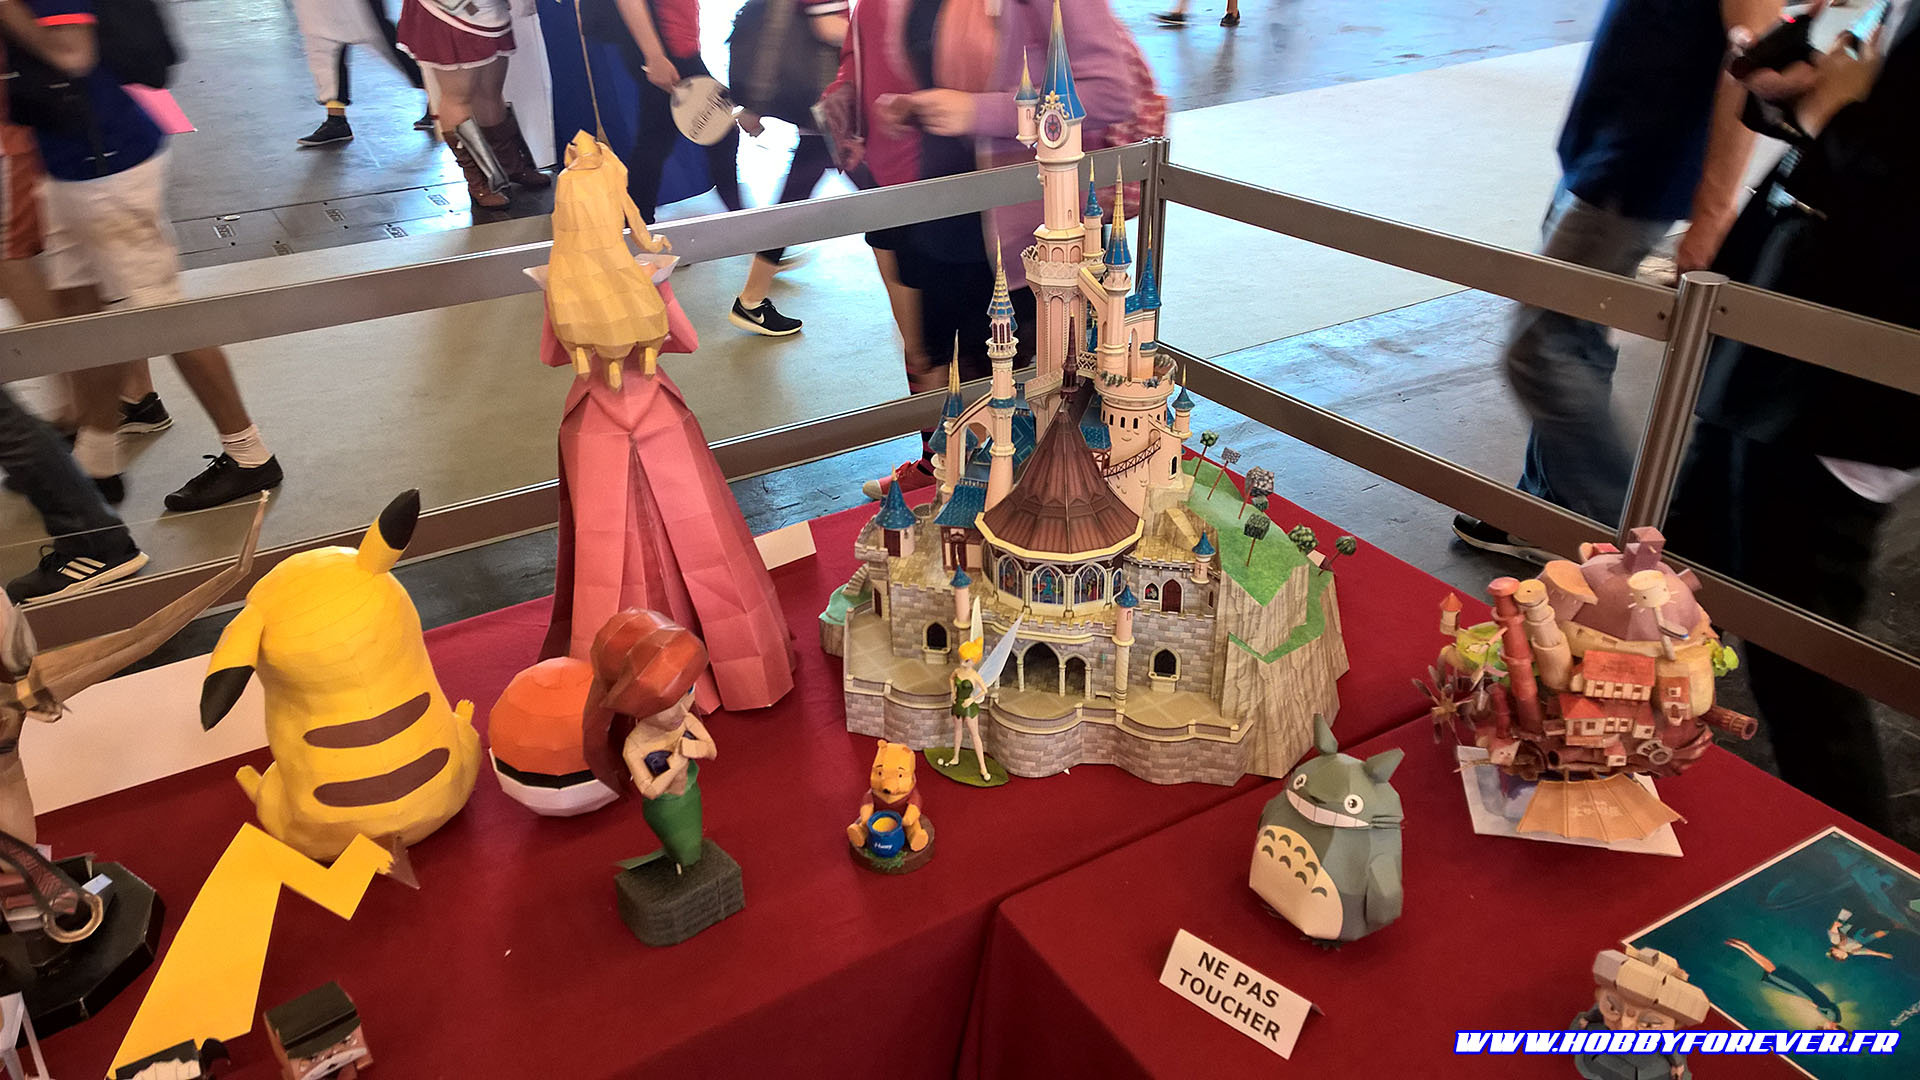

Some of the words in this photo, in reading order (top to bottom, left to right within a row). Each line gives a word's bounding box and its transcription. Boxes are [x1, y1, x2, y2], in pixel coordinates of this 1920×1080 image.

[1179, 968, 1280, 1042] TOUCHER
[1198, 952, 1229, 980] NE
[1233, 971, 1279, 1008] PAS
